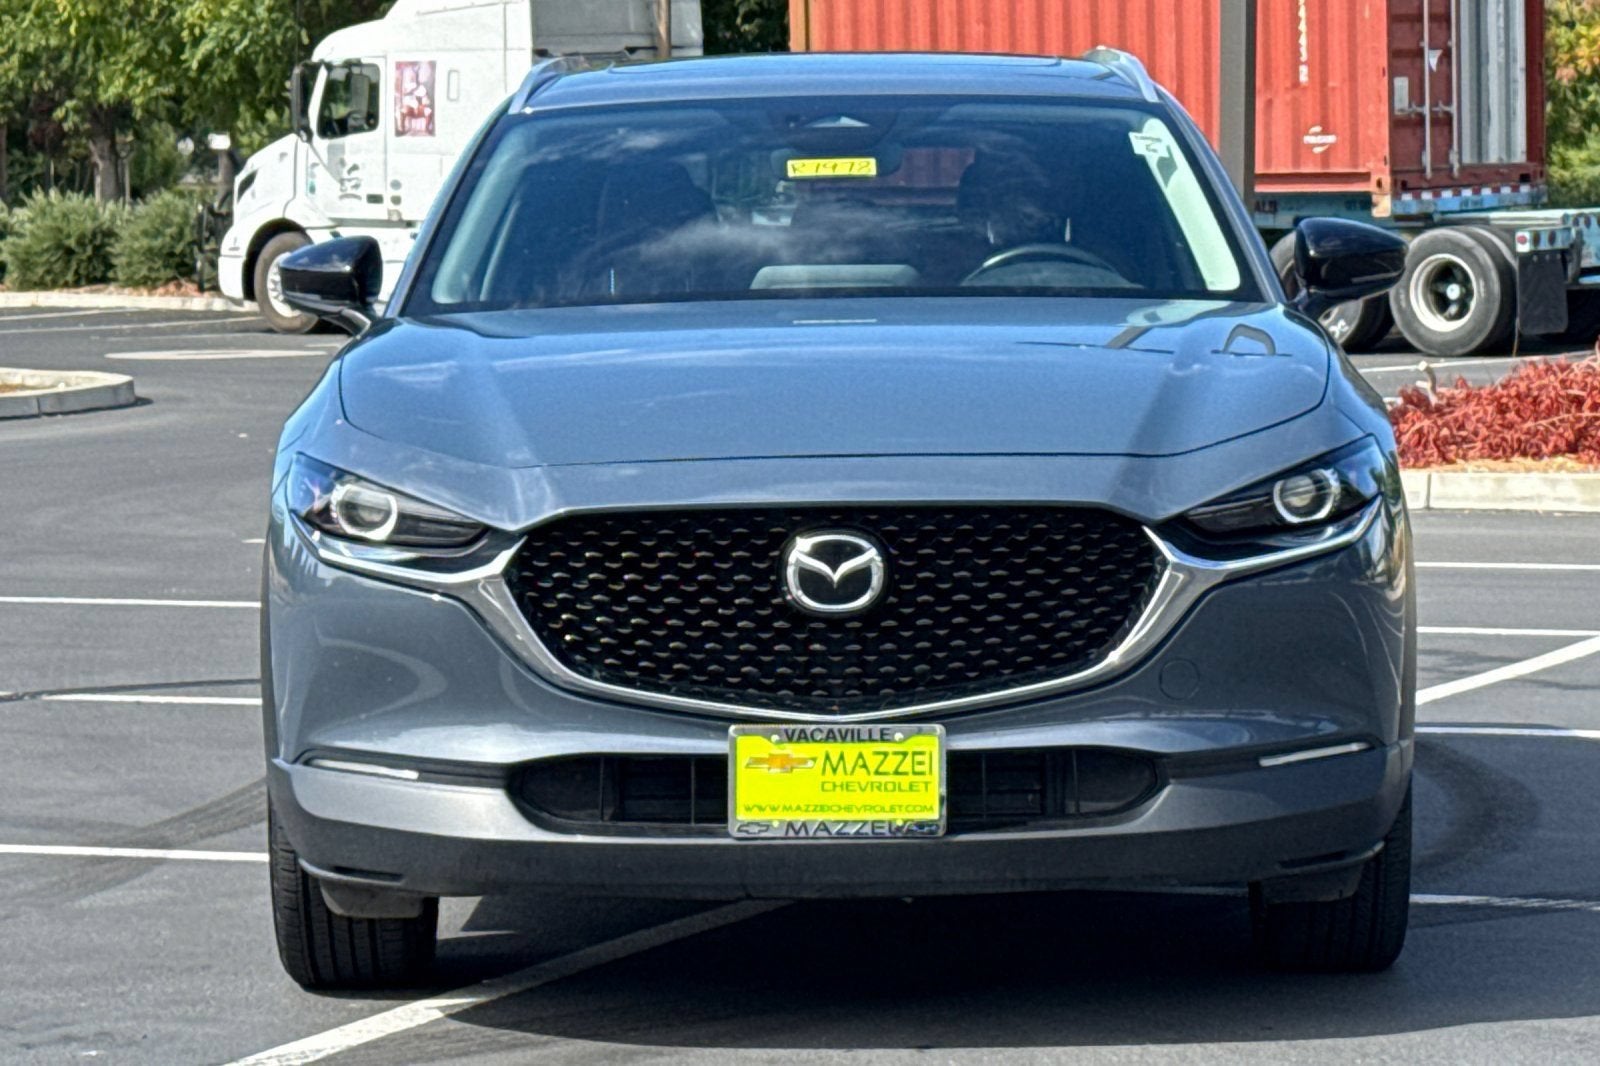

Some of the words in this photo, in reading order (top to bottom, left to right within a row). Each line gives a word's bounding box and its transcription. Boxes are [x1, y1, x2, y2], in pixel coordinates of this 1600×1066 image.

[784, 728, 891, 742] VACAVILLE
[821, 751, 933, 776] MAZZEI
[821, 781, 931, 793] CHEVROLET
